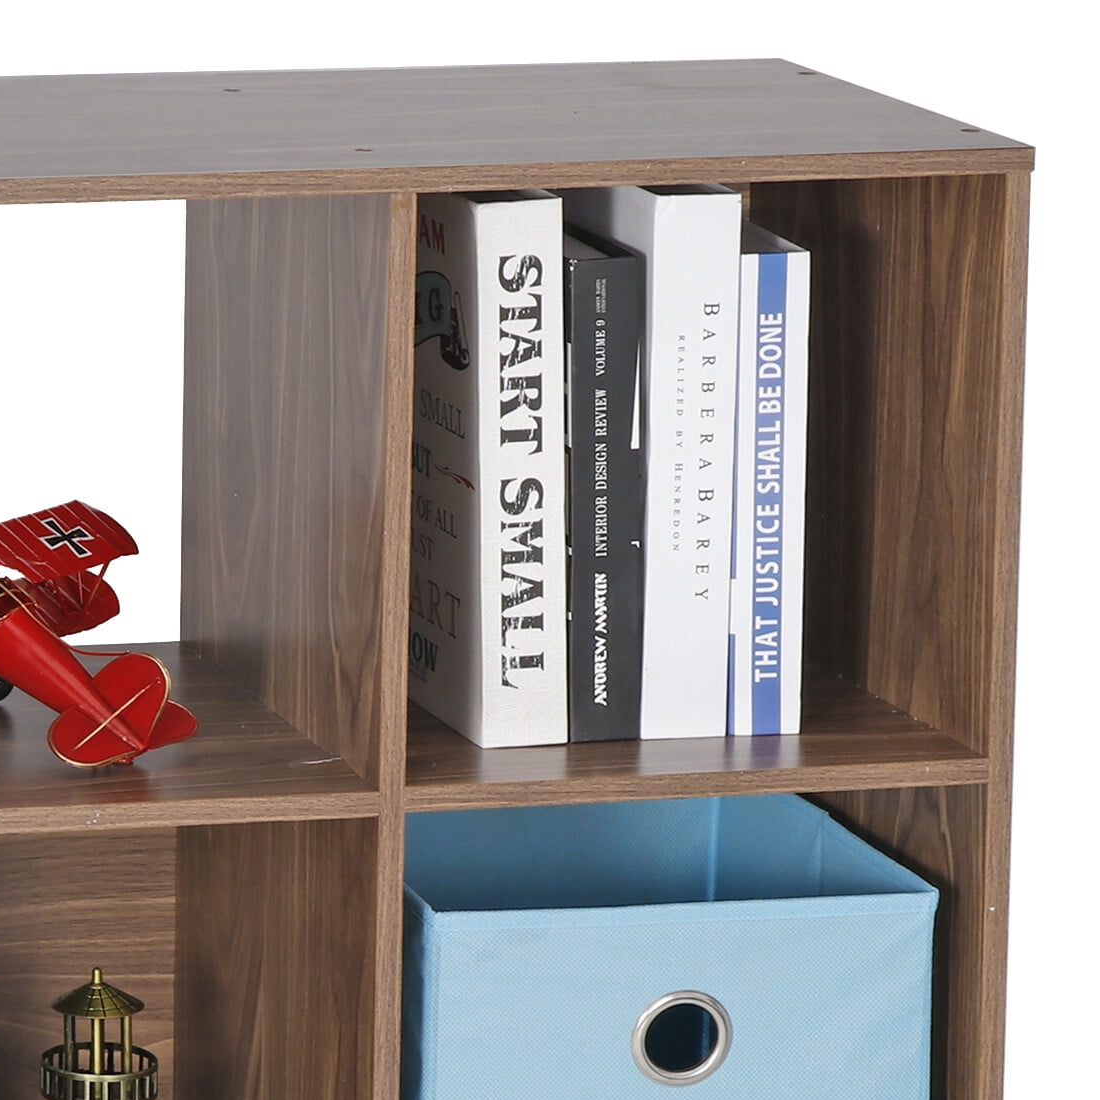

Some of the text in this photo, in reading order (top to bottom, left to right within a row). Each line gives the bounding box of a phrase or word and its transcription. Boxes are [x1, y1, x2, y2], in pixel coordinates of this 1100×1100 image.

[595, 329, 606, 376] VOLUME
[420, 389, 466, 439] SMALL
[595, 388, 607, 436] REVIEW
[673, 334, 685, 551] REALIZED BY HENREDON
[498, 255, 544, 690] START SMALL
[595, 443, 608, 490] DESIGN
[695, 303, 721, 600] BARBERA BAREY
[417, 495, 458, 539] OF ALL
[595, 495, 608, 557] INTERIOR
[755, 312, 783, 683] THAT JUSTICE SHALL BE DONE
[594, 572, 607, 634] MARTIN
[594, 636, 607, 706] ANDREW
